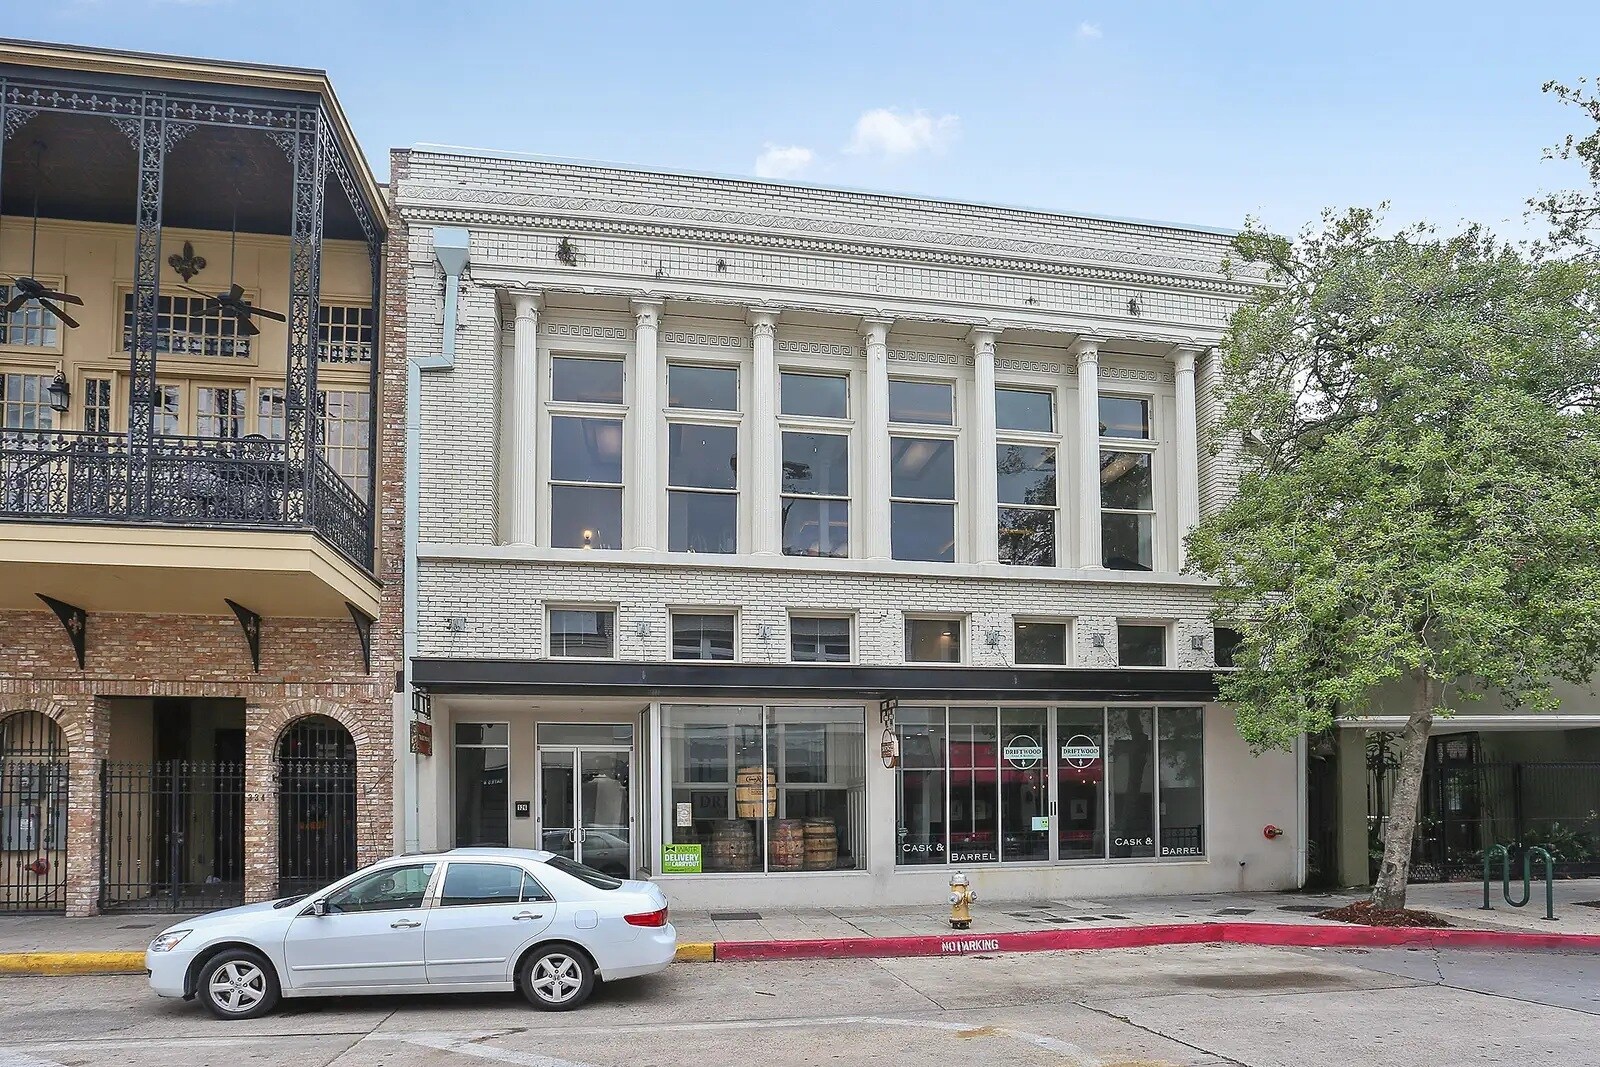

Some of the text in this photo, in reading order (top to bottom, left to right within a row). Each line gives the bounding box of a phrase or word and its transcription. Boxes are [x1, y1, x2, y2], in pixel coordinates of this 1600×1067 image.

[1114, 837, 1153, 846] CASK &
[902, 843, 945, 852] CASK &
[1162, 847, 1203, 855] BARREL
[664, 853, 699, 861] DELIVERY
[951, 853, 996, 861] BARREL
[942, 939, 999, 952] NO PARKING
